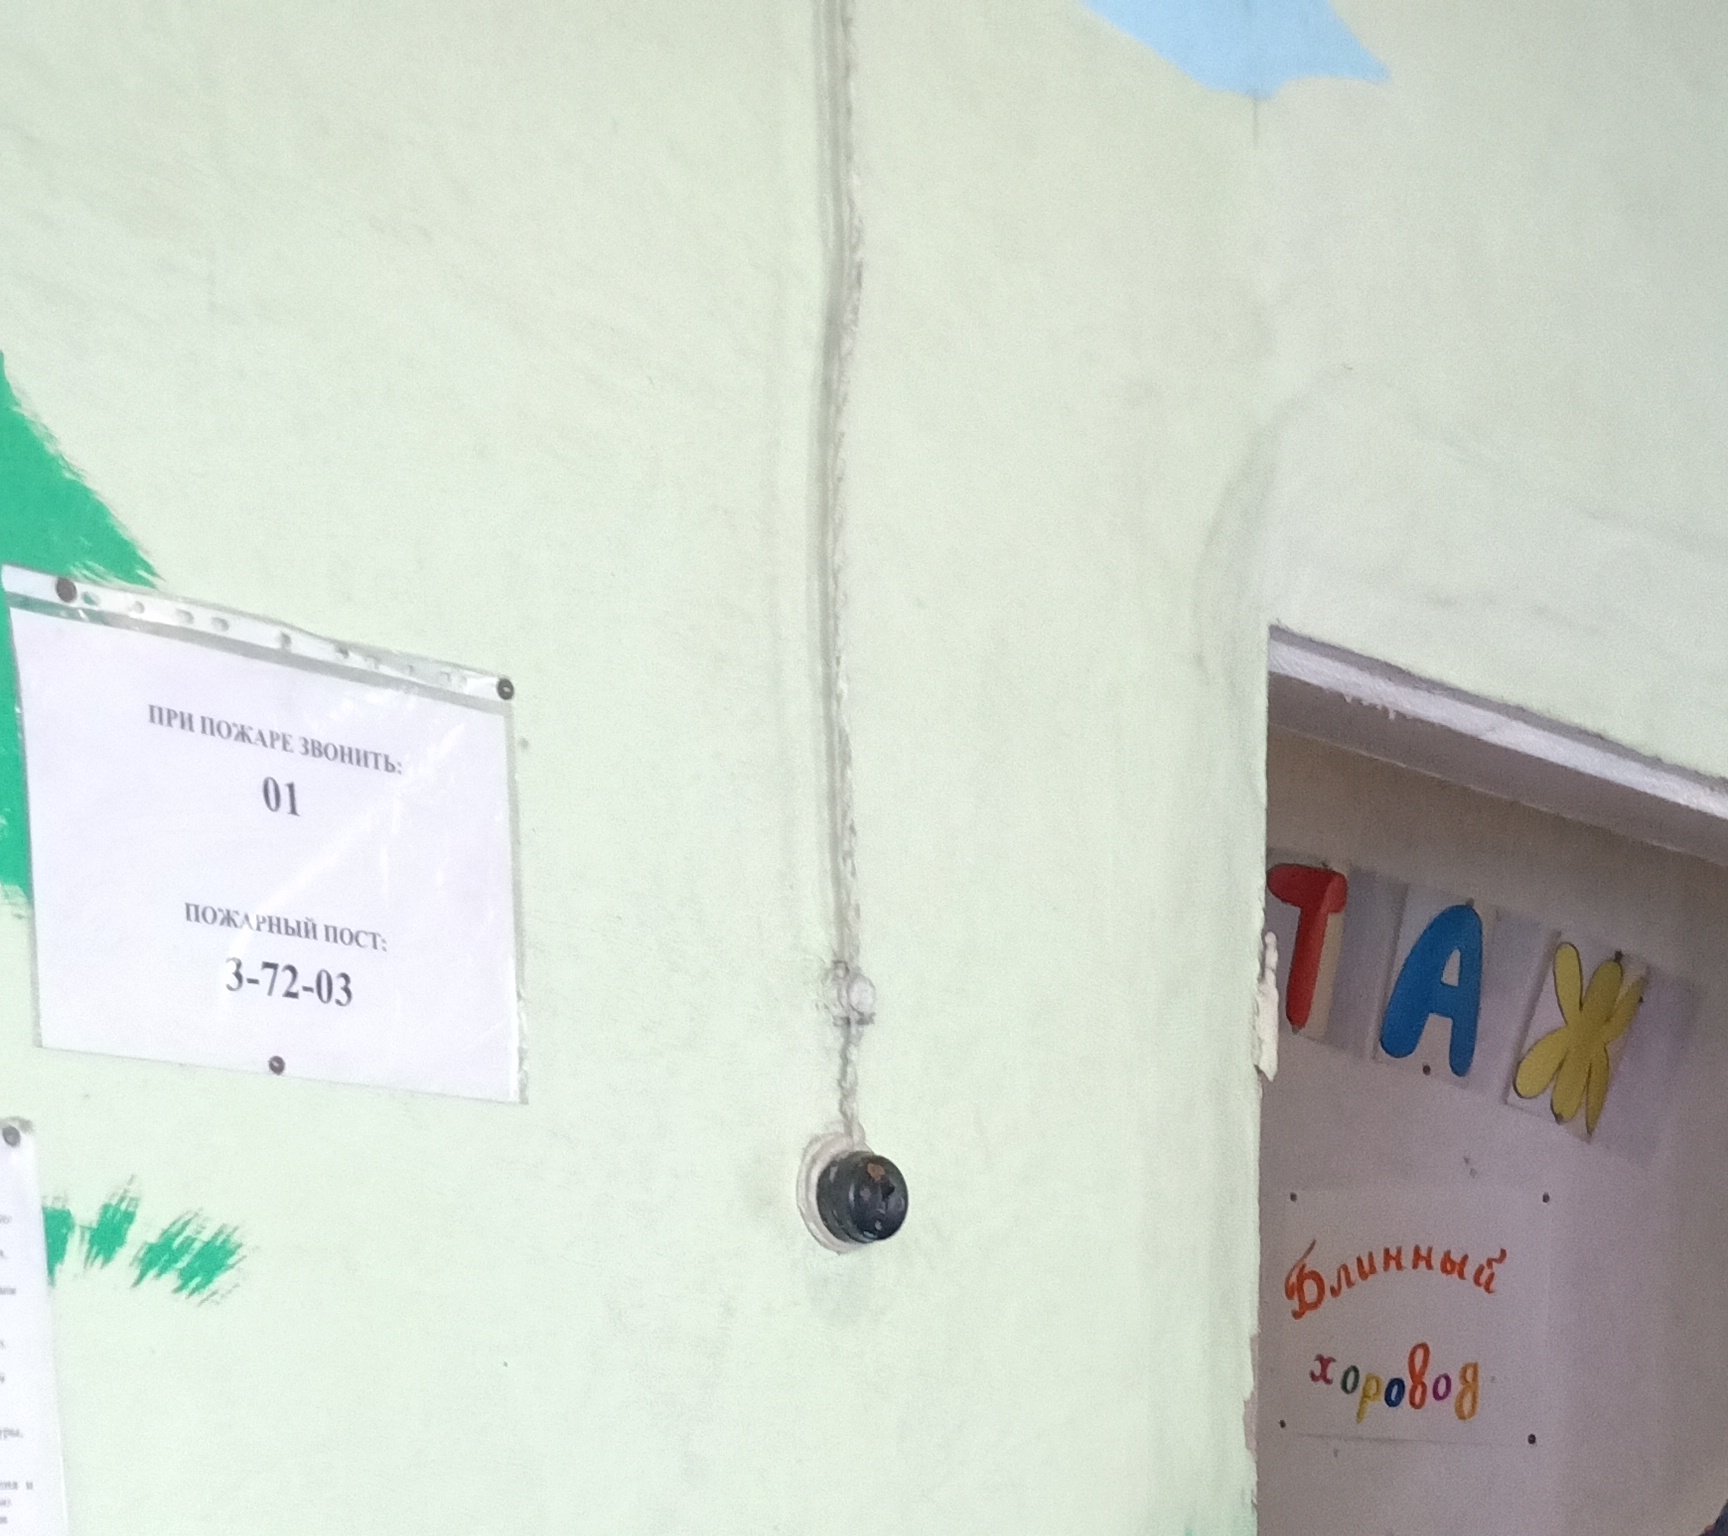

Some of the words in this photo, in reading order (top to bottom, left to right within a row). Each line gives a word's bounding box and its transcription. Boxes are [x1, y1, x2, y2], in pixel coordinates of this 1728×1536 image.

[148, 703, 195, 734] ПРИ
[199, 714, 295, 754] ПОЖАРЕ
[298, 735, 403, 776] ЗВОНИТЬ:
[261, 775, 301, 817] 01
[184, 902, 319, 941] ПОЖАРНЫЙ
[323, 923, 388, 952] ПОСТ:
[225, 956, 353, 1008] 3-72-03
[1283, 1238, 1507, 1320] Блинный
[1308, 1341, 1480, 1424] хоровод
